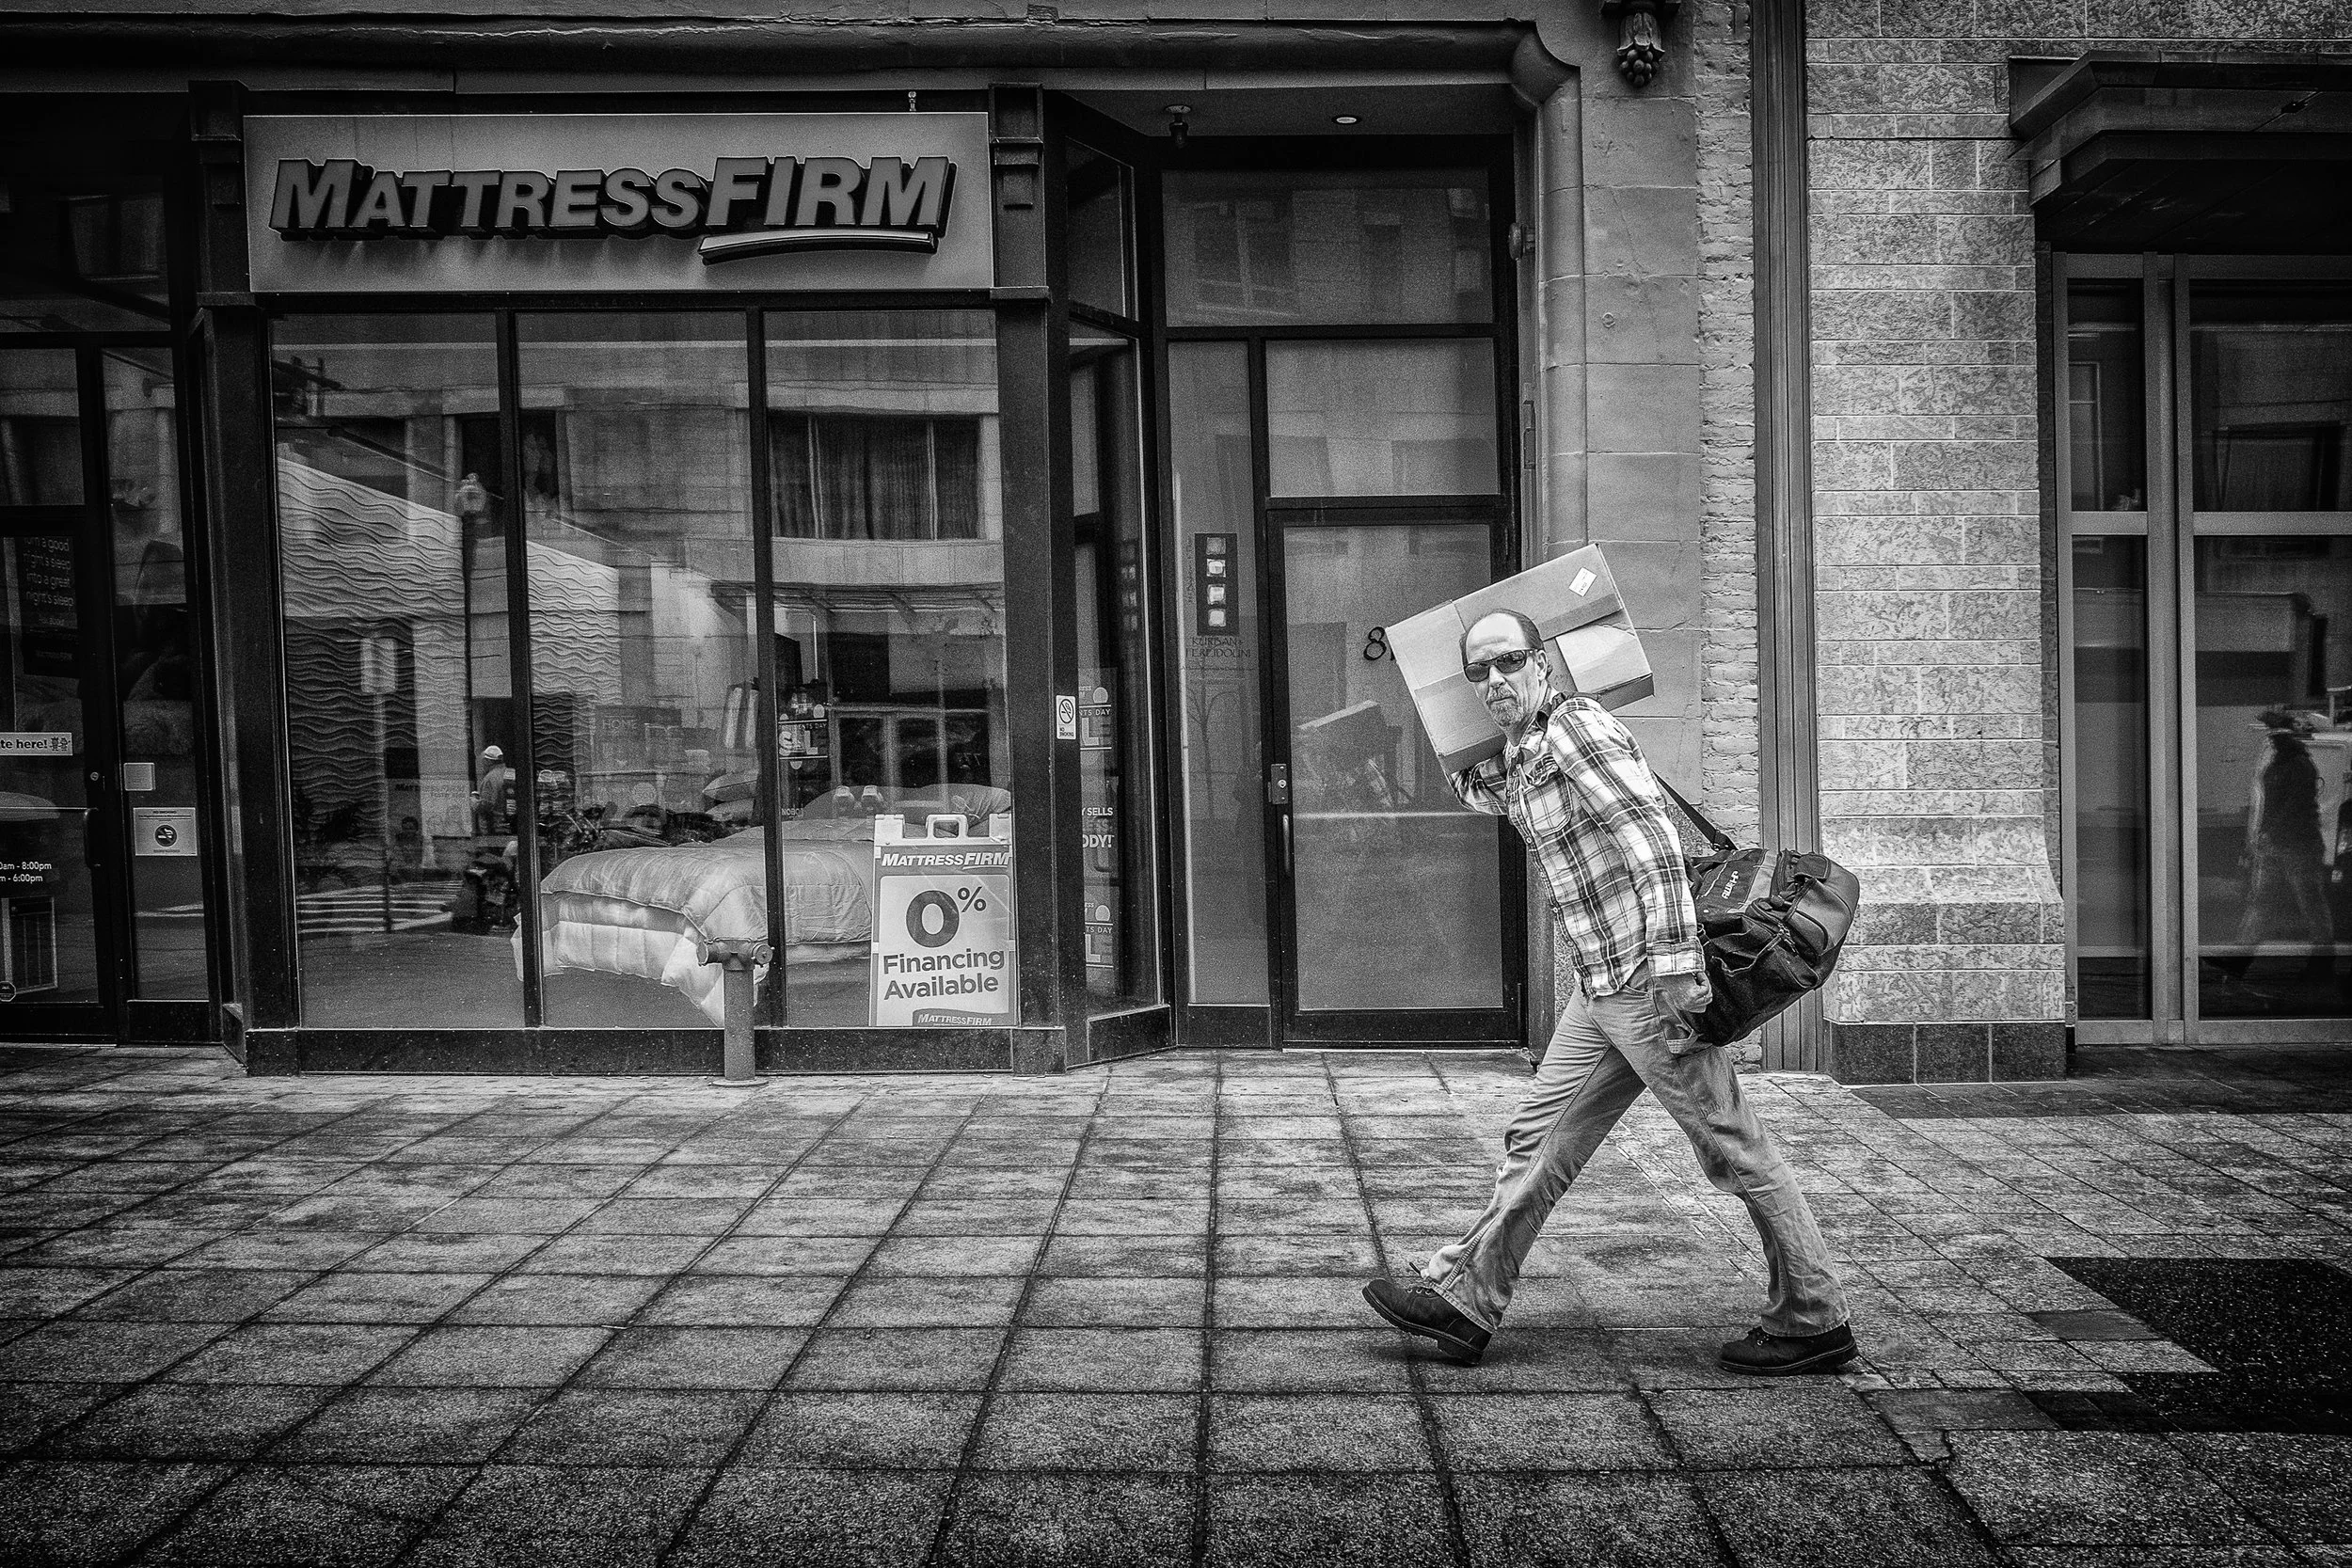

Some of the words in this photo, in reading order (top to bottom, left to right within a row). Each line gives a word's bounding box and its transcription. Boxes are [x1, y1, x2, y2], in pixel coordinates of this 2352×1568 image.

[1363, 626, 1395, 661] 8
[16, 738, 47, 749] here!
[1087, 807, 1113, 816] SELLS
[22, 862, 52, 872] 8:00pm
[13, 874, 43, 884] 6:00pm
[883, 948, 1005, 974] Financing
[883, 973, 999, 1000] Available
